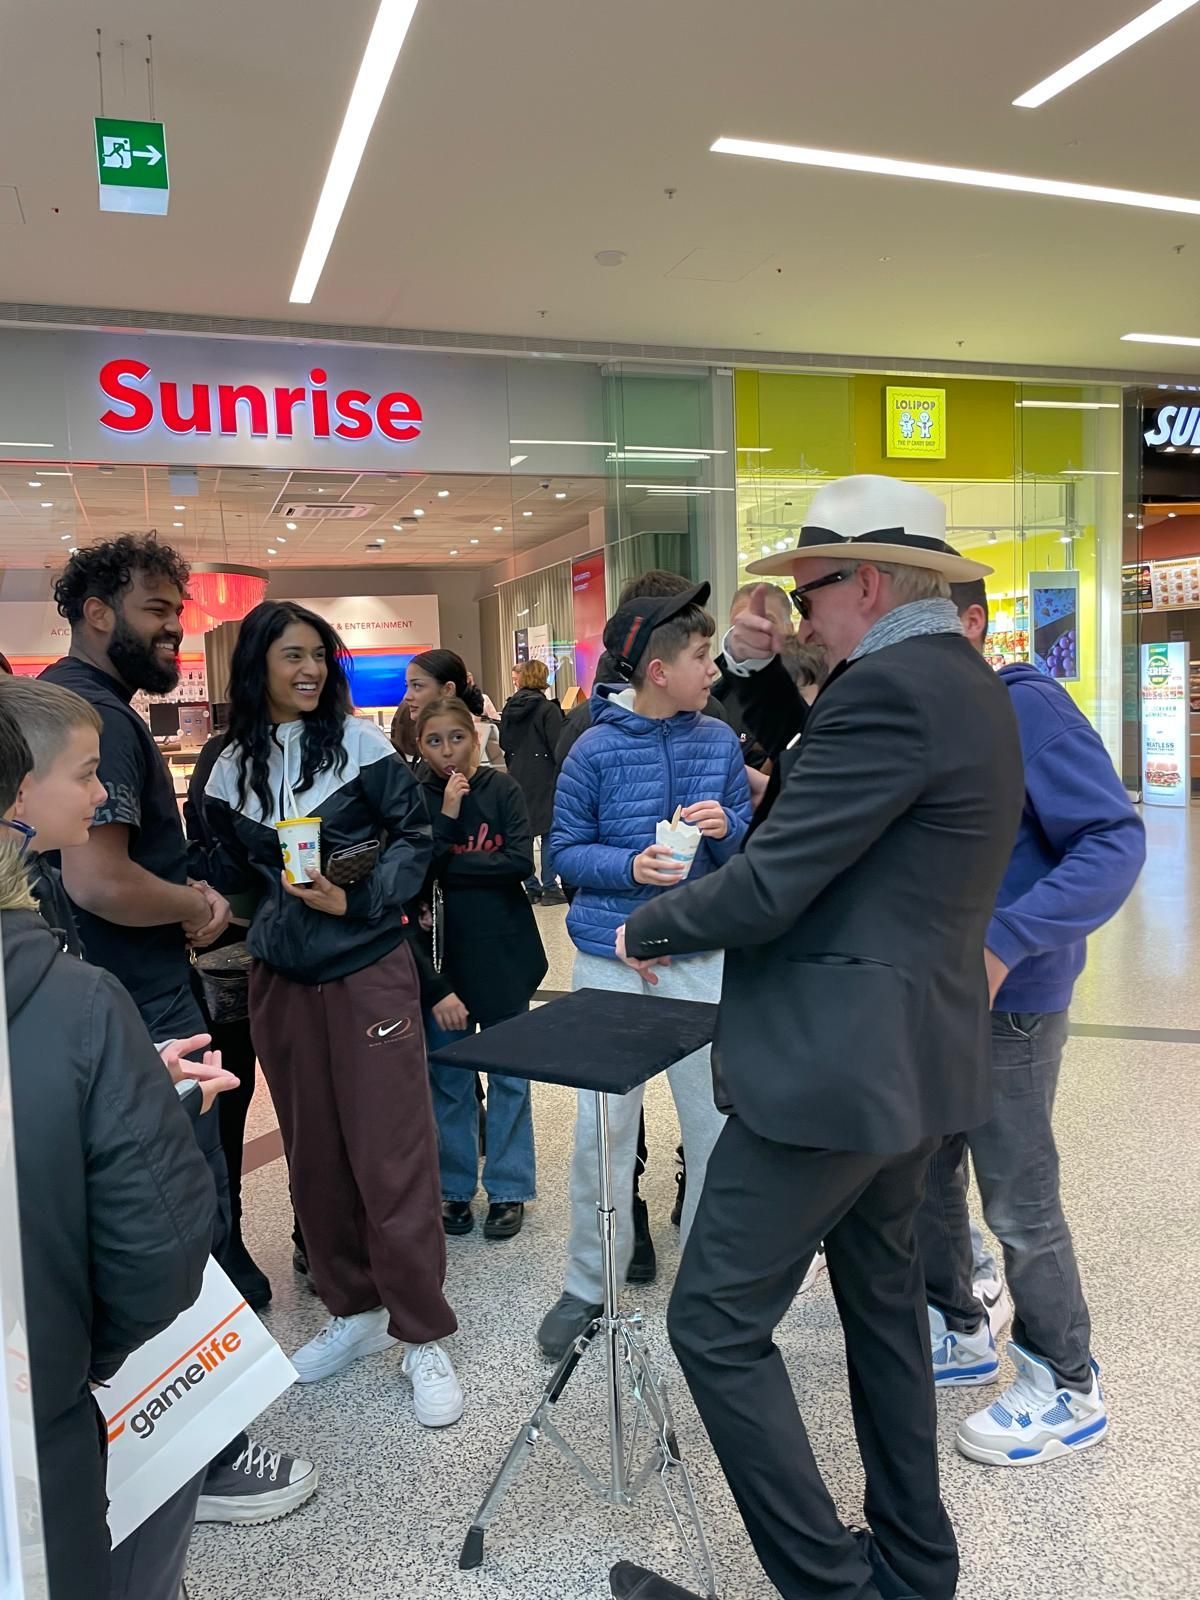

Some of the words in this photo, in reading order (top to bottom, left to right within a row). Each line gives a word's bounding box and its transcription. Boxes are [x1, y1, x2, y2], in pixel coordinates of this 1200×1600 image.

[99, 359, 423, 442] Sunrise
[895, 400, 936, 410] LOLIPOP
[345, 621, 413, 630] ENTERTAINMENT
[130, 1331, 242, 1439] gamelife
